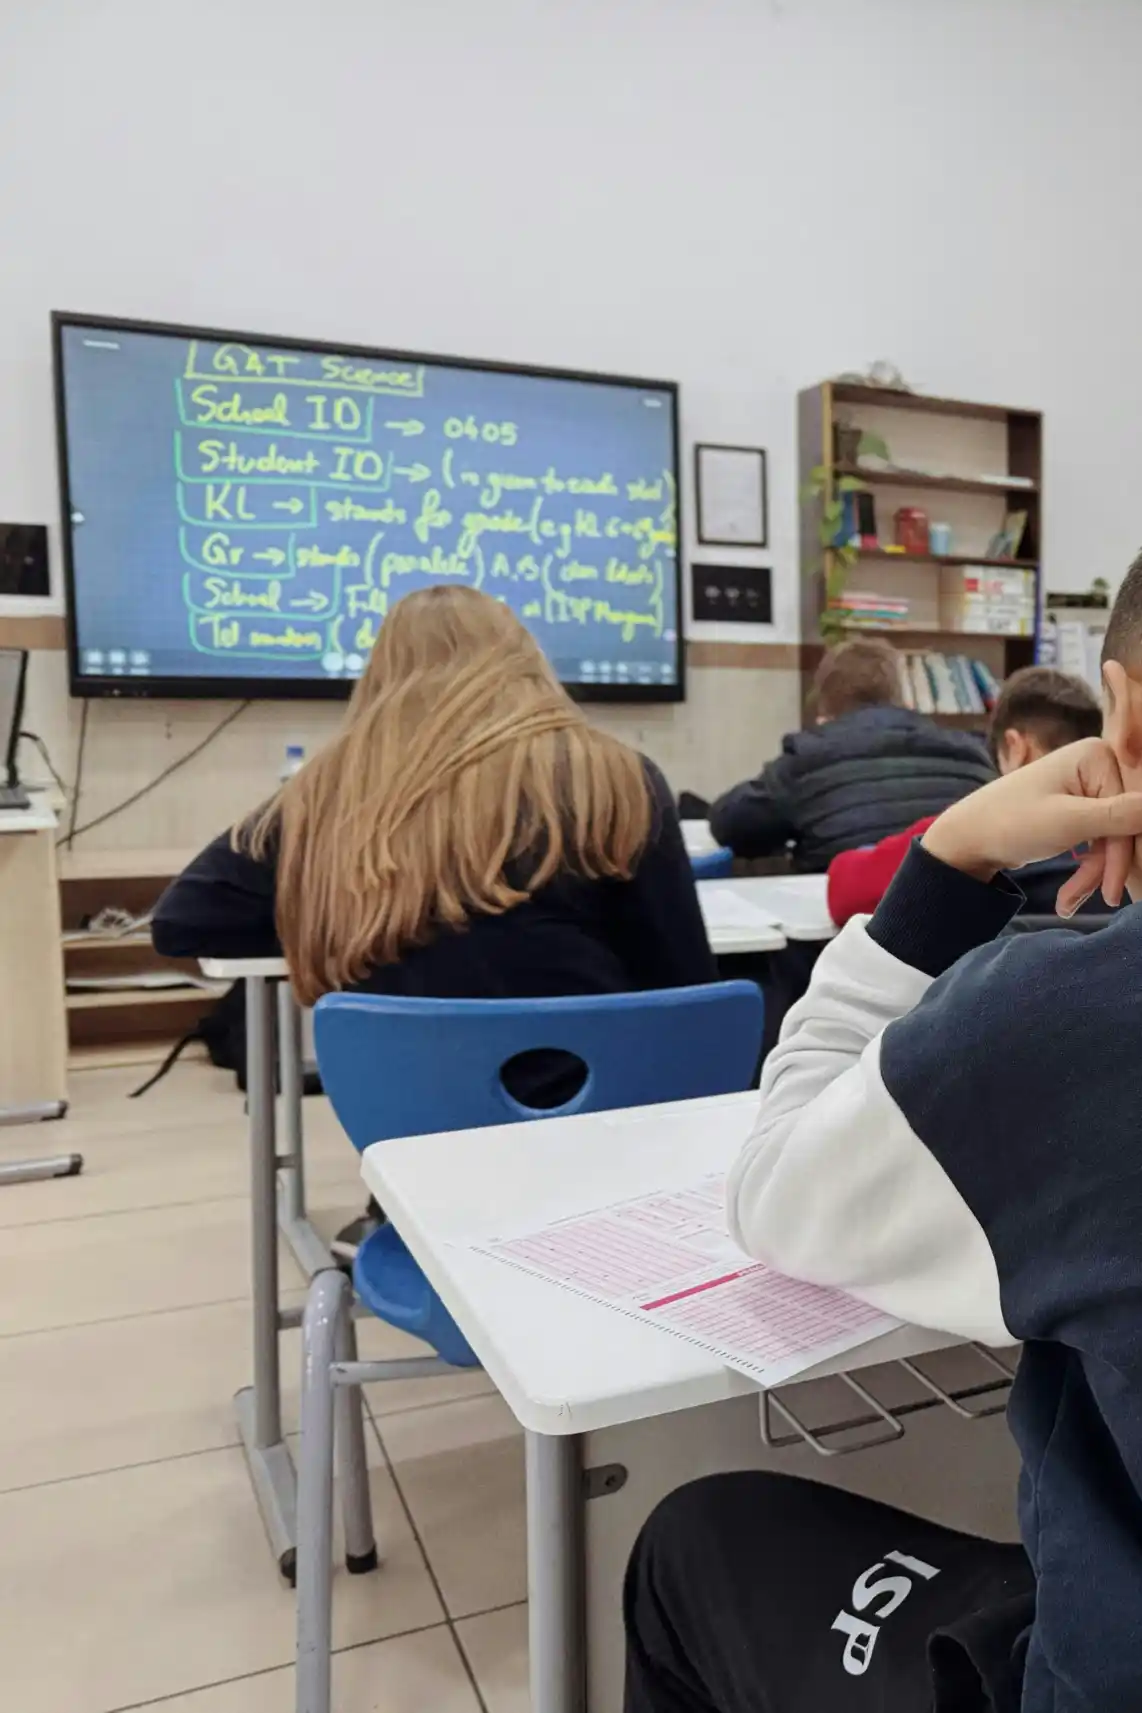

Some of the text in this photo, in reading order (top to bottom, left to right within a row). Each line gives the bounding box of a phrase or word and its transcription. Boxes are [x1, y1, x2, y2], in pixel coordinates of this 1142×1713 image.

[192, 384, 518, 446] School ID 0405
[198, 440, 320, 474] Student
[329, 447, 384, 481] ID
[206, 480, 256, 520] KL
[202, 532, 244, 565] Gr
[204, 577, 282, 612] School
[830, 1550, 942, 1676] ISP
